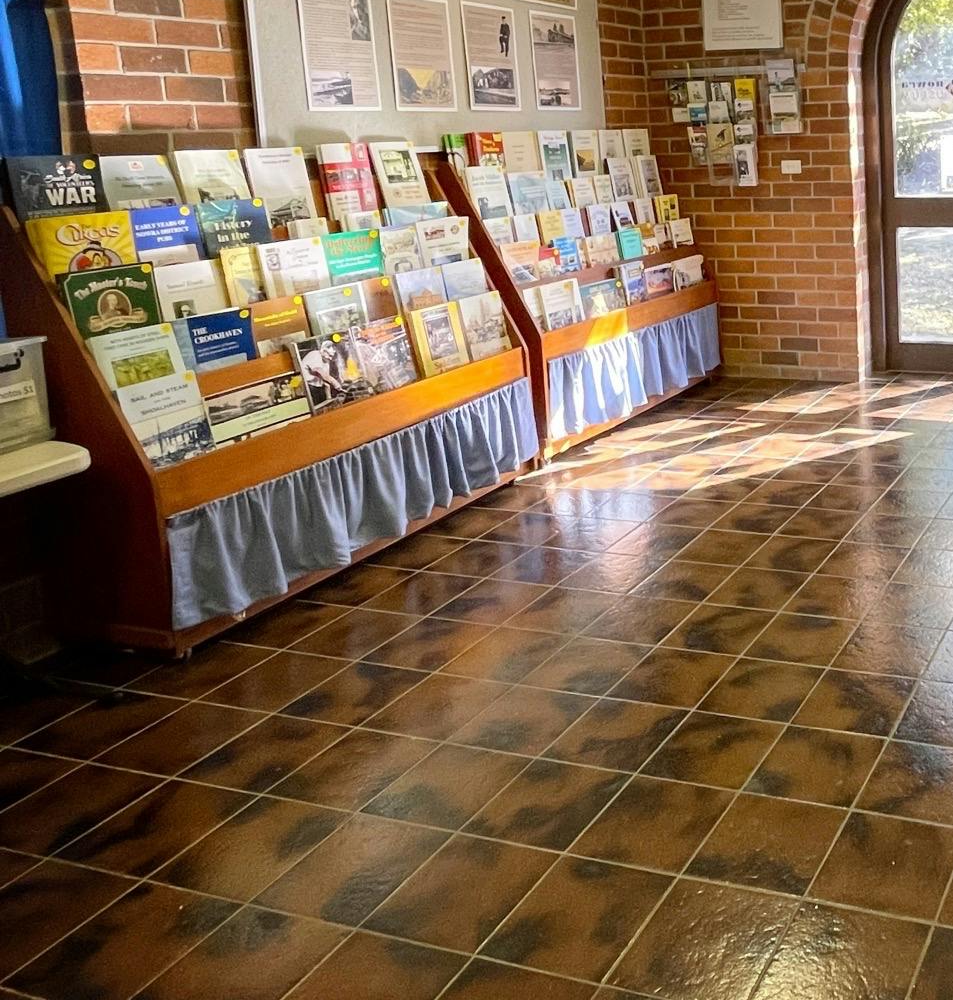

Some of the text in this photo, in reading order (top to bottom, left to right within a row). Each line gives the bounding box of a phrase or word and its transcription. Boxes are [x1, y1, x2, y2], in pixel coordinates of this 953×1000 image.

[45, 186, 97, 206] WAR
[134, 219, 187, 231] EARLY YEARS OF
[135, 226, 189, 238] NOWRA DISTRICT
[192, 327, 208, 337] THE
[194, 328, 243, 345] CROOKHAVEN
